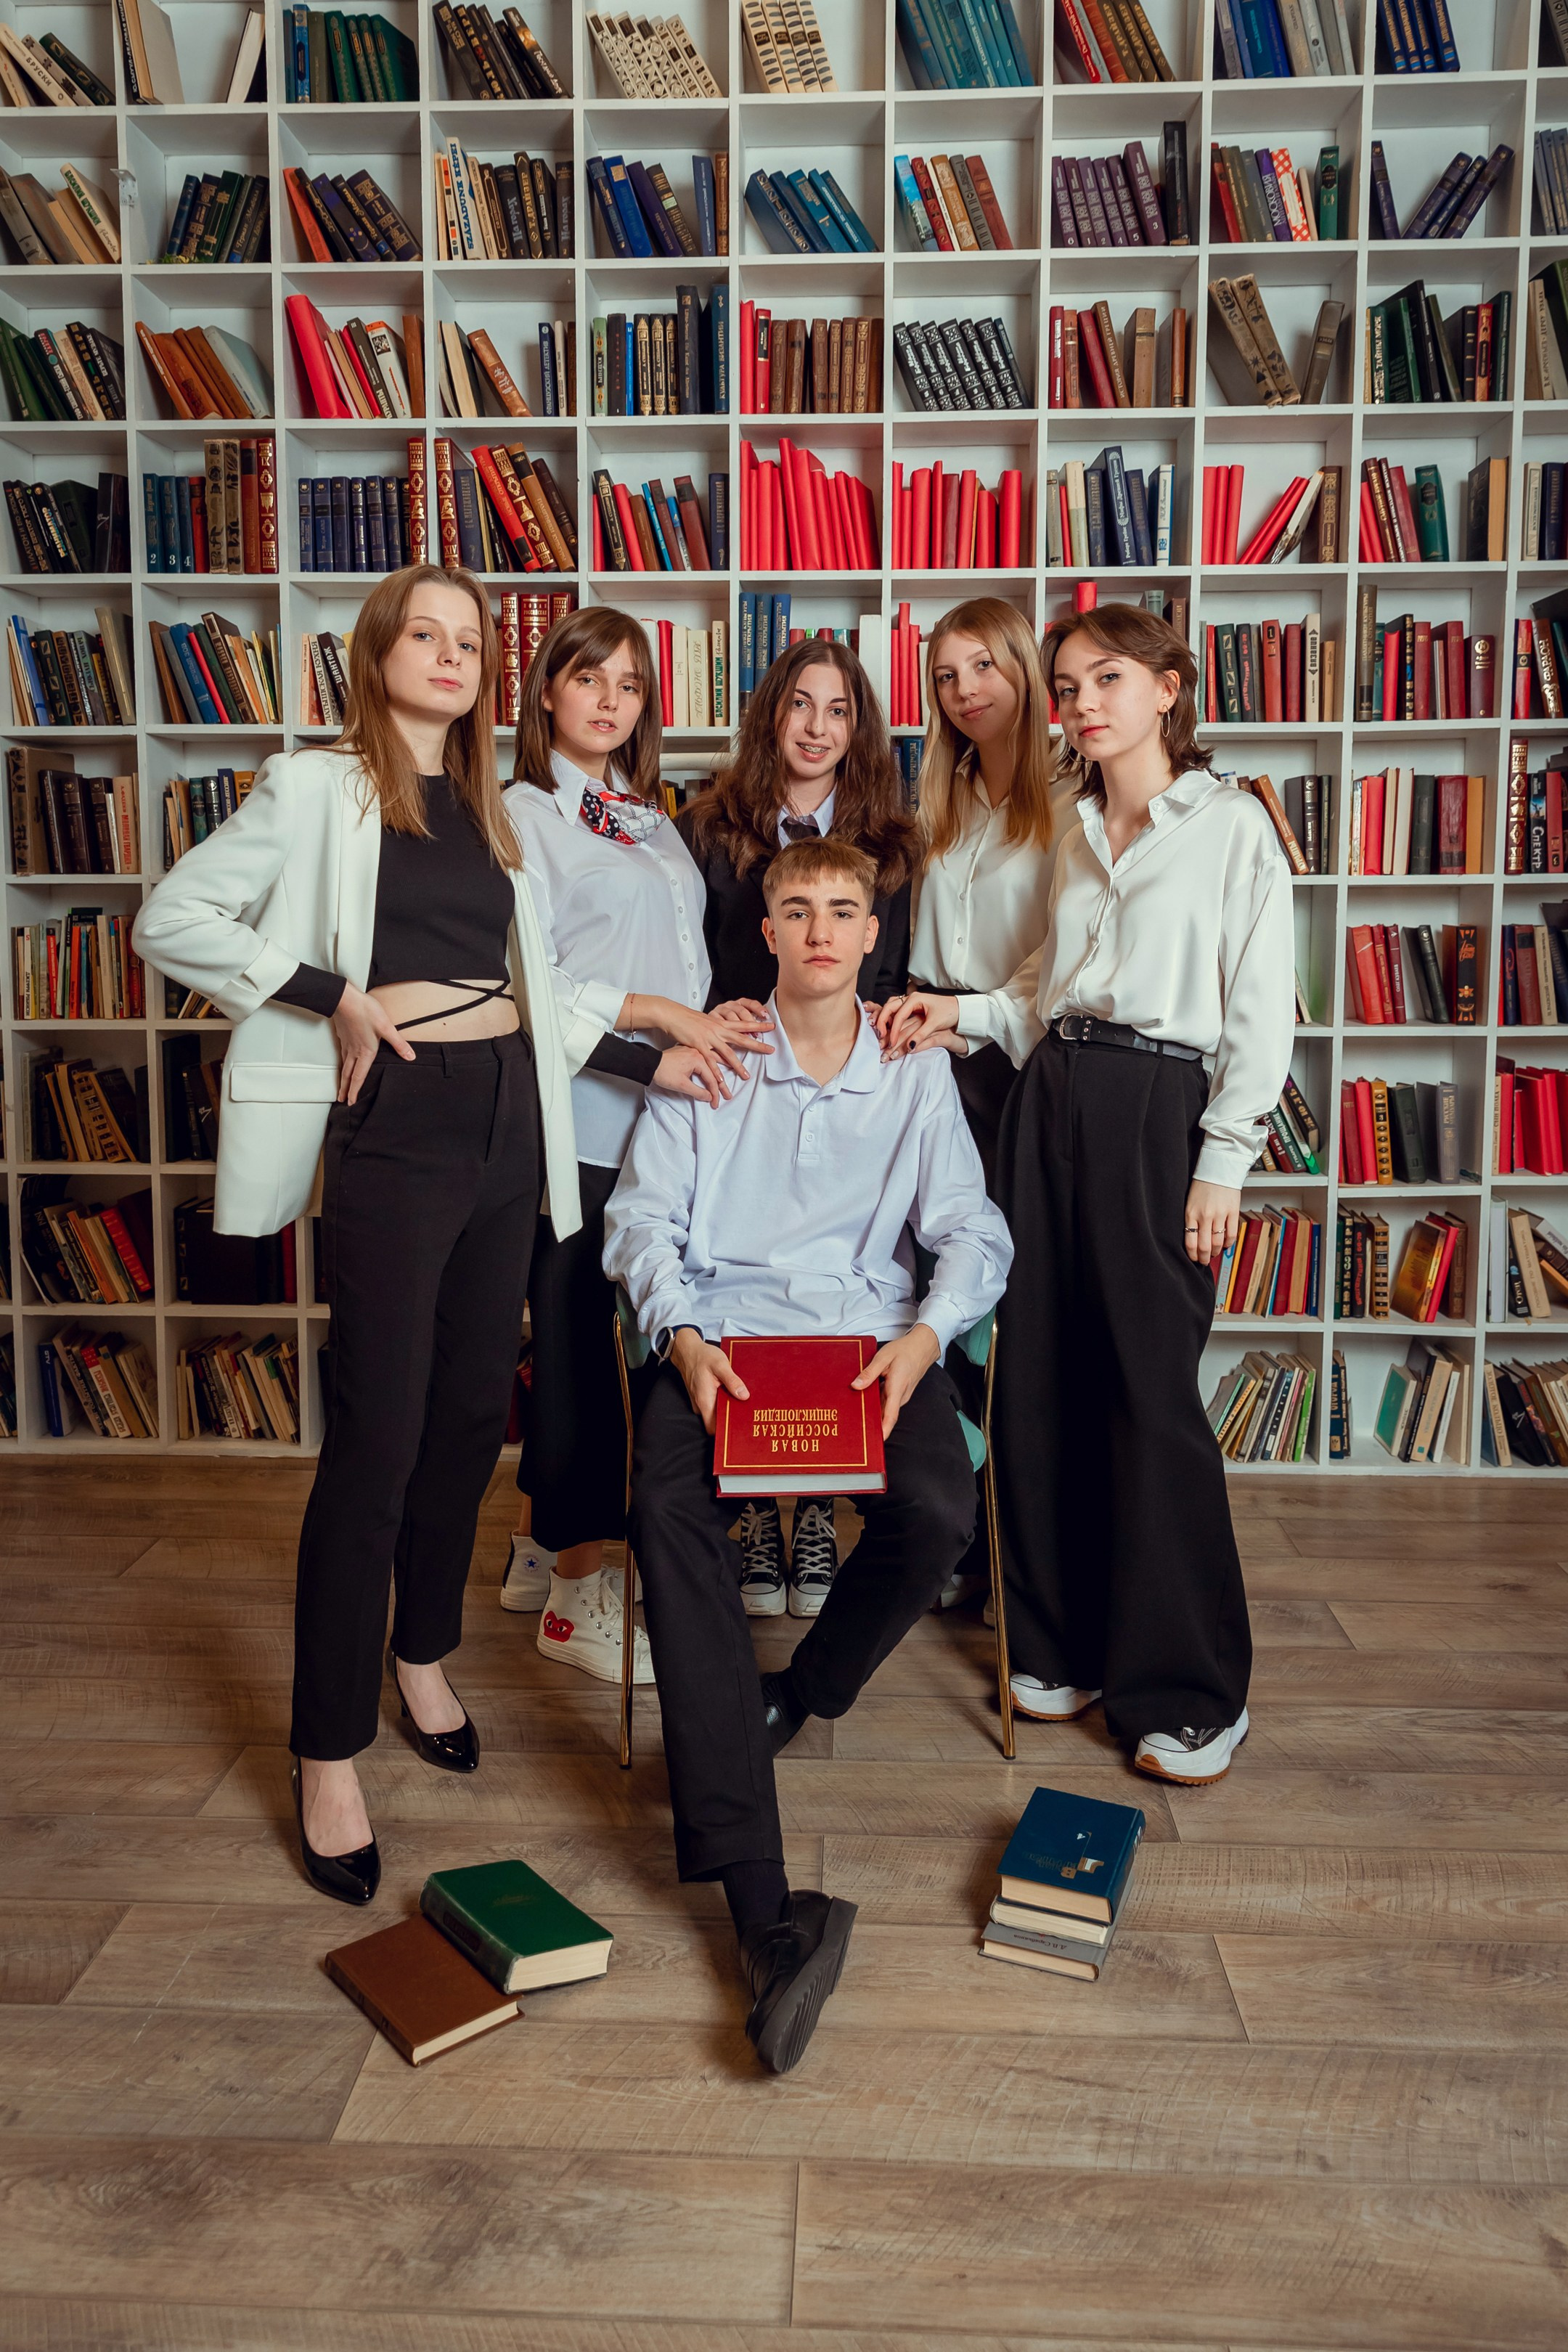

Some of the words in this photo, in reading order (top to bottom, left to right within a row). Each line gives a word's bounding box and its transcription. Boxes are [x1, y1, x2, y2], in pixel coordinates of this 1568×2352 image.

[25, 56, 53, 86] БРУСКИ
[449, 142, 462, 177] KÉPEI
[1260, 173, 1282, 226] МОСКОВИЯ
[1113, 368, 1126, 398] ИСТОРИЯ
[21, 534, 36, 565] ПЛАТОН
[149, 552, 156, 563] 2
[168, 554, 176, 565] 3
[444, 544, 457, 554] XIV
[310, 640, 322, 668] КУХНЯ
[322, 645, 342, 684] ШАНТАЖ
[316, 669, 333, 723] ЛАТЫШСКАЯ
[508, 697, 517, 707] IV
[1273, 1112, 1291, 1143] ПРОЩАНИЕ
[753, 1408, 838, 1421] ЭНЦИКЛОПЕДИЯ
[753, 1424, 838, 1438] РОССИЙСКАЯ
[771, 1440, 819, 1452] НОВАЯ
